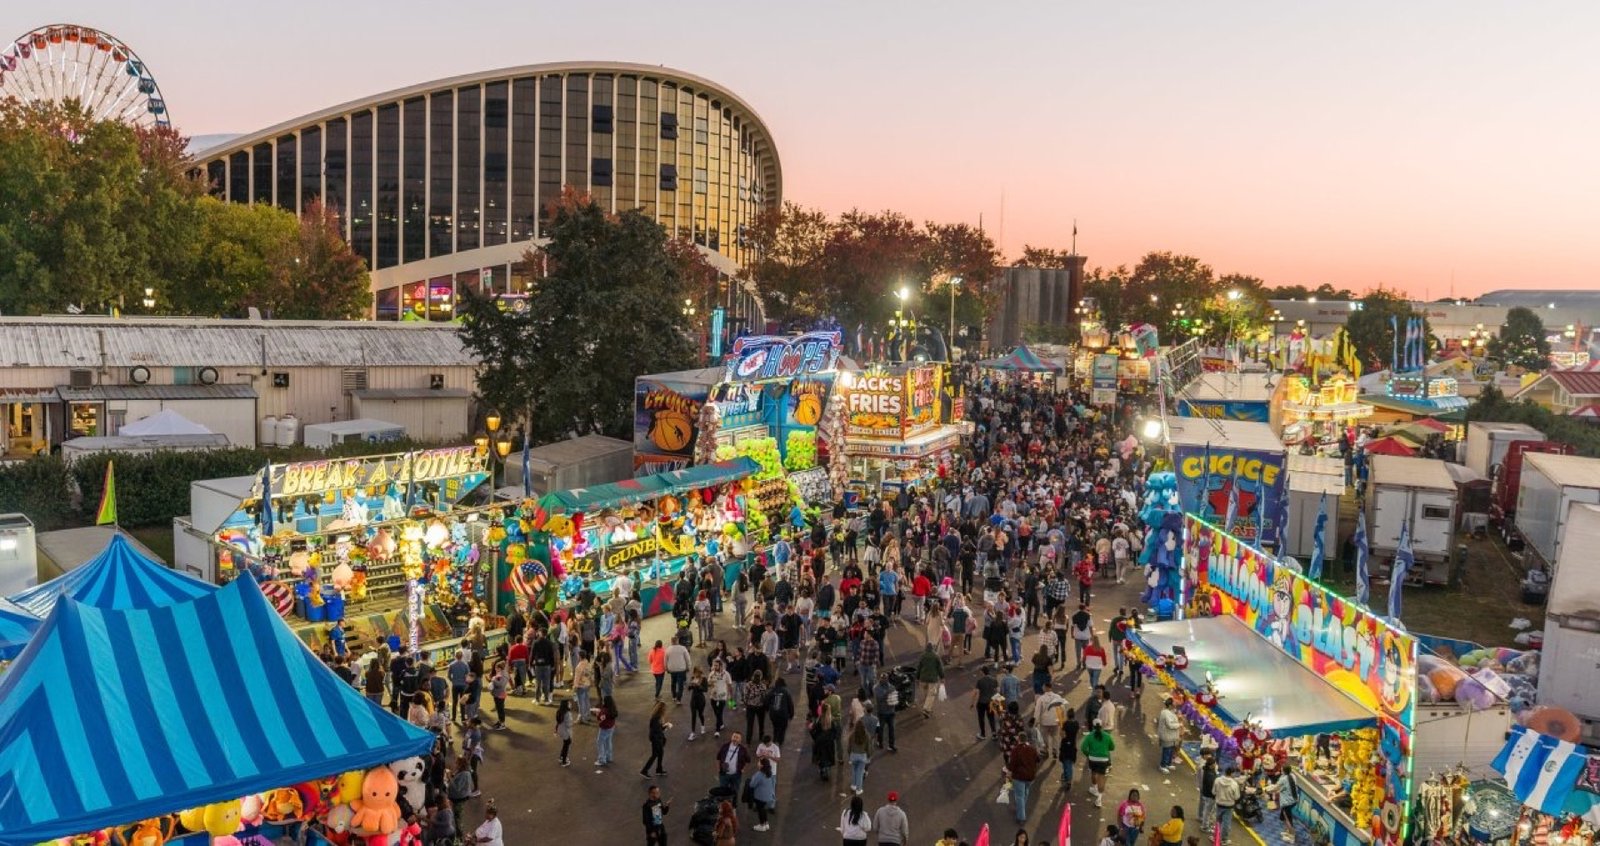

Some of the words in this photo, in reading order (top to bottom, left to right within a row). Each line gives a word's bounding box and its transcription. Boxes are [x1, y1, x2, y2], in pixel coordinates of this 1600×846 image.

[763, 341, 829, 377] HOOPS
[849, 376, 902, 392] JACK'S
[849, 393, 901, 415] FRIES
[282, 460, 360, 494] BREAK
[369, 459, 388, 484] A
[399, 446, 470, 480] BOTTLE
[1181, 455, 1281, 485] CHOICE
[1208, 553, 1272, 619] BALLOON
[1298, 603, 1376, 683] BLAST
